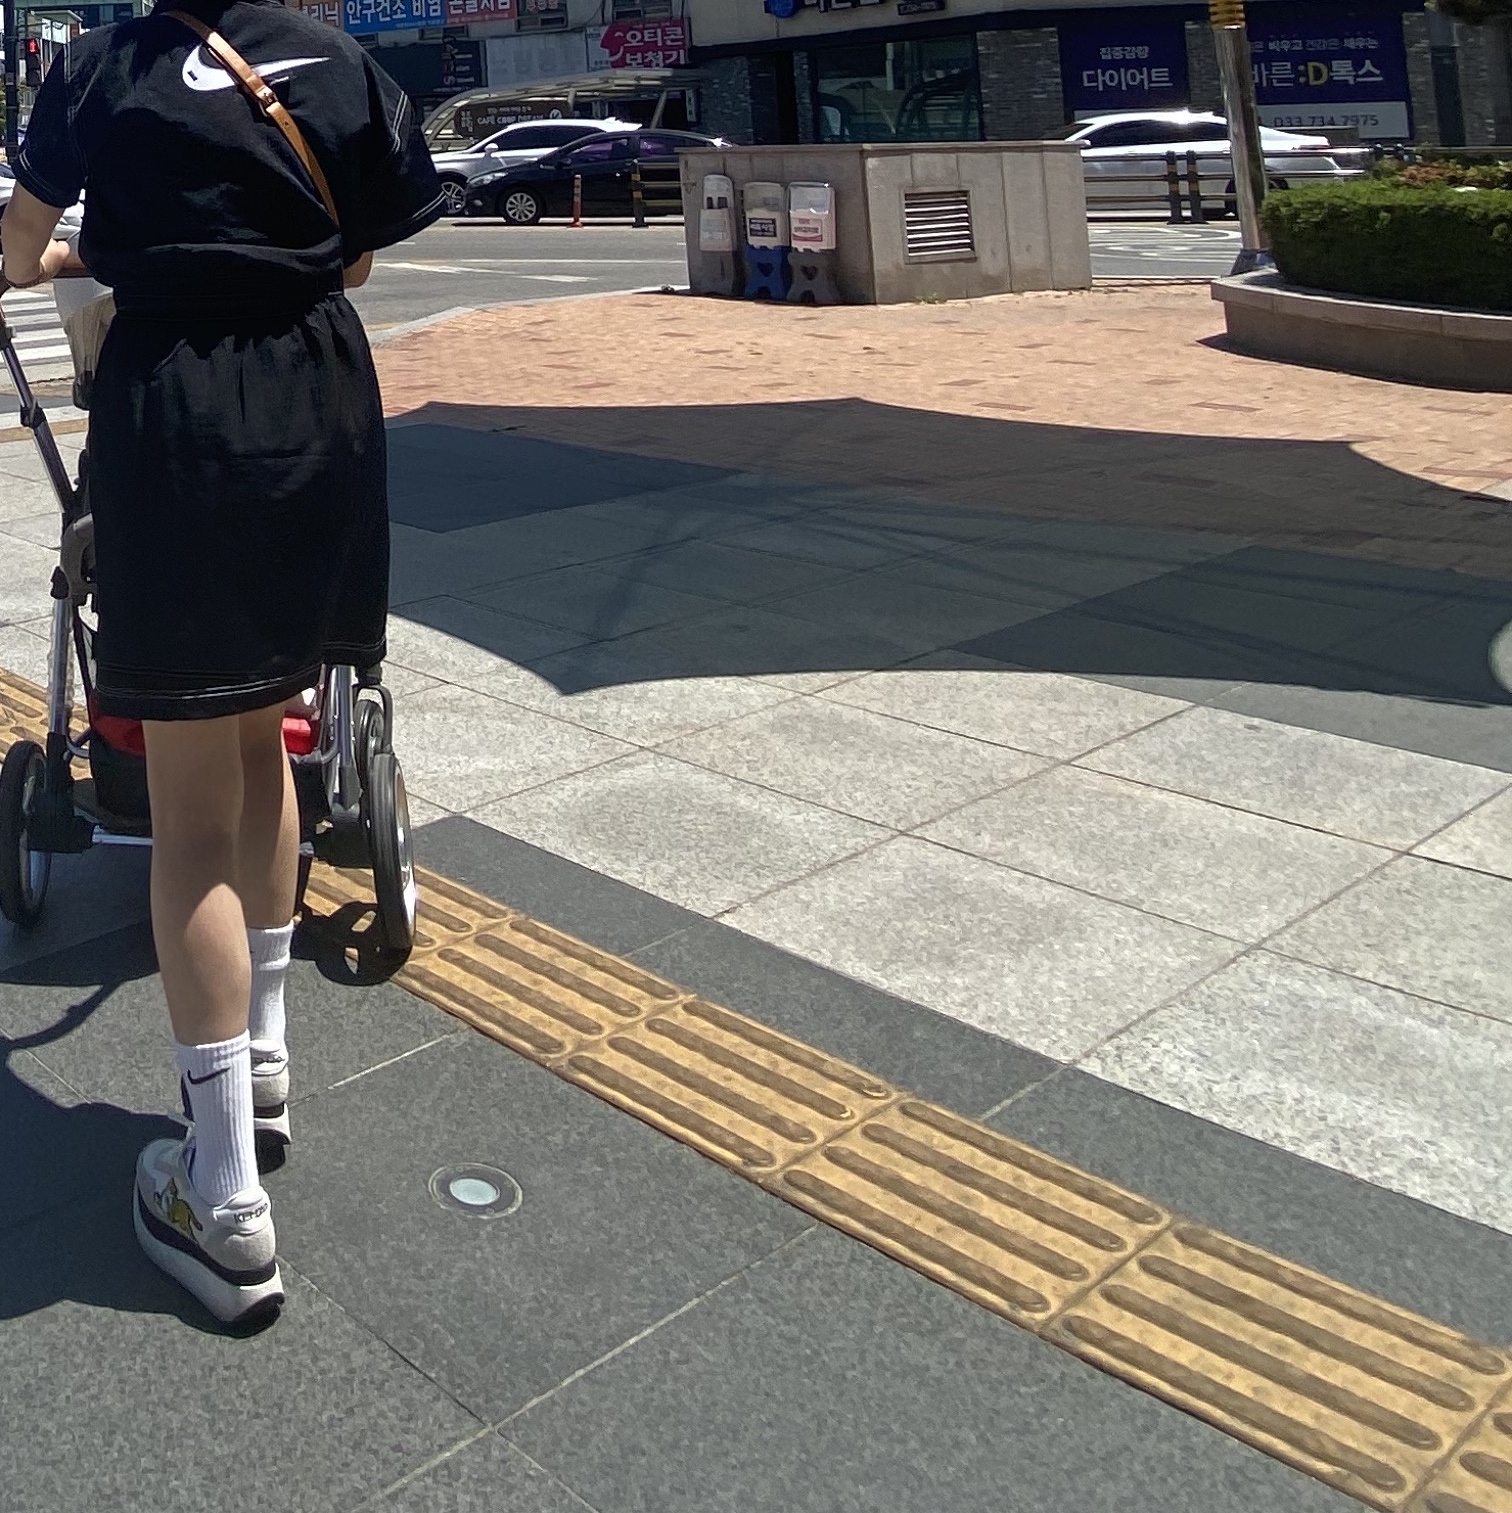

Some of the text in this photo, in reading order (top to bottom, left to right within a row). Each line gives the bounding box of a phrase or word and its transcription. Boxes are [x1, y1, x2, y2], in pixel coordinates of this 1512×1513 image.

[624, 27, 684, 47] 오티콘
[626, 50, 685, 68] 보청기
[1083, 67, 1173, 91] 다이어트
